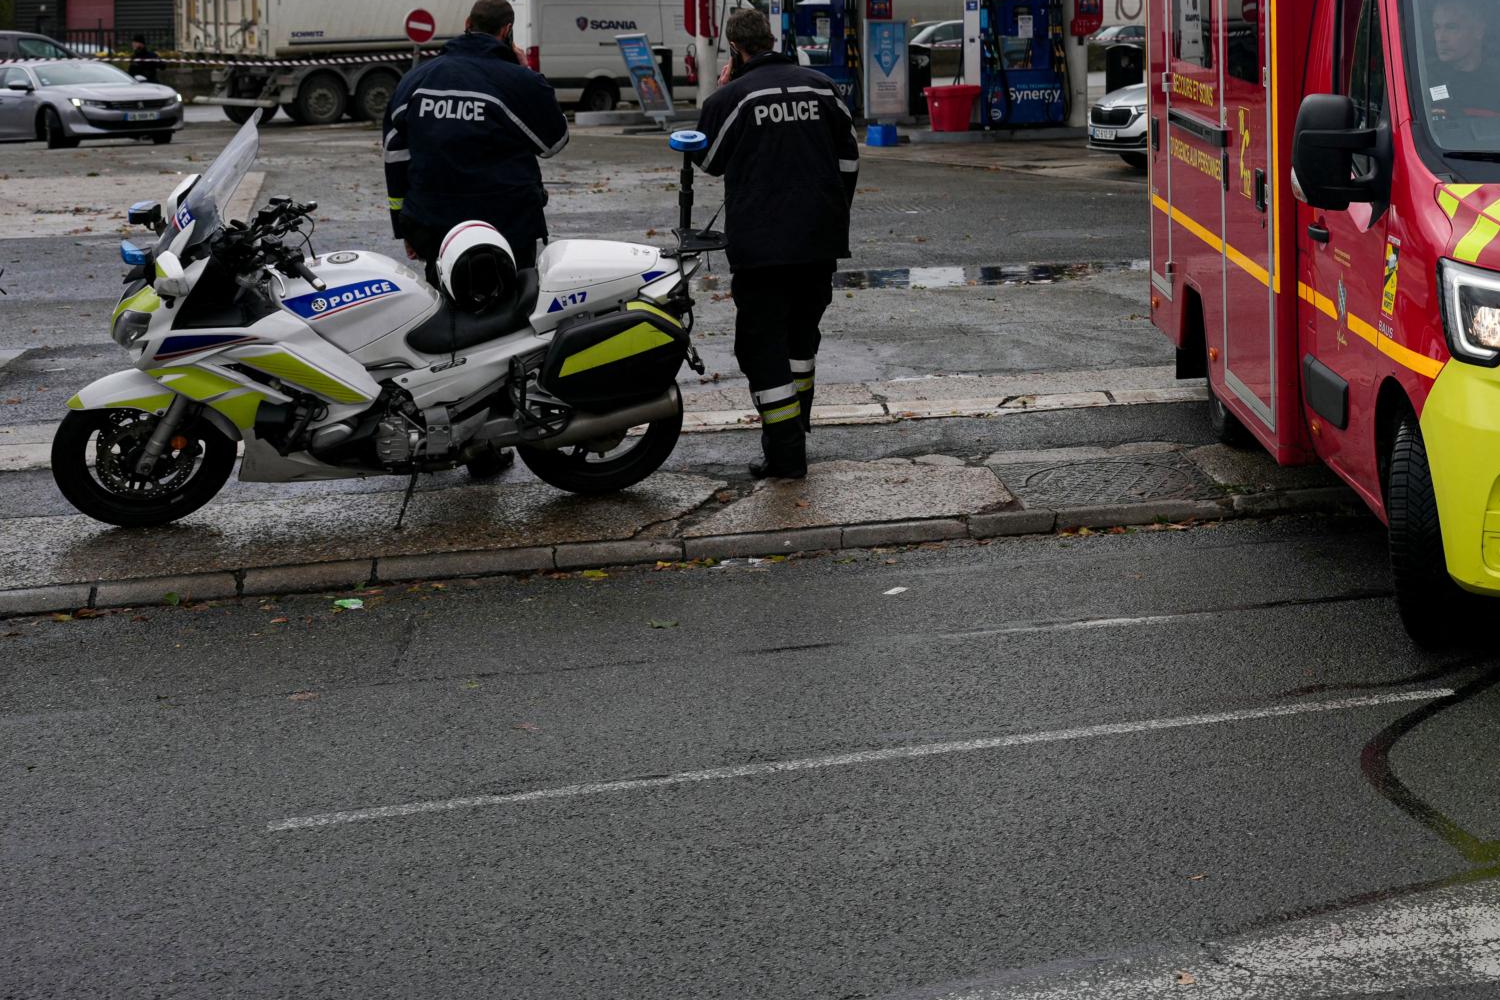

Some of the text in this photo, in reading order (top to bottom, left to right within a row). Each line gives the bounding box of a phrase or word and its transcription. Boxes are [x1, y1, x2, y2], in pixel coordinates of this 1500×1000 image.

[590, 19, 638, 30] SCANIA
[1009, 87, 1061, 104] Synergy
[419, 97, 486, 121] POLICE
[754, 100, 821, 126] POLICE
[328, 281, 393, 308] POLICE
[568, 291, 588, 305] 17
[1378, 320, 1394, 339] BAUS
